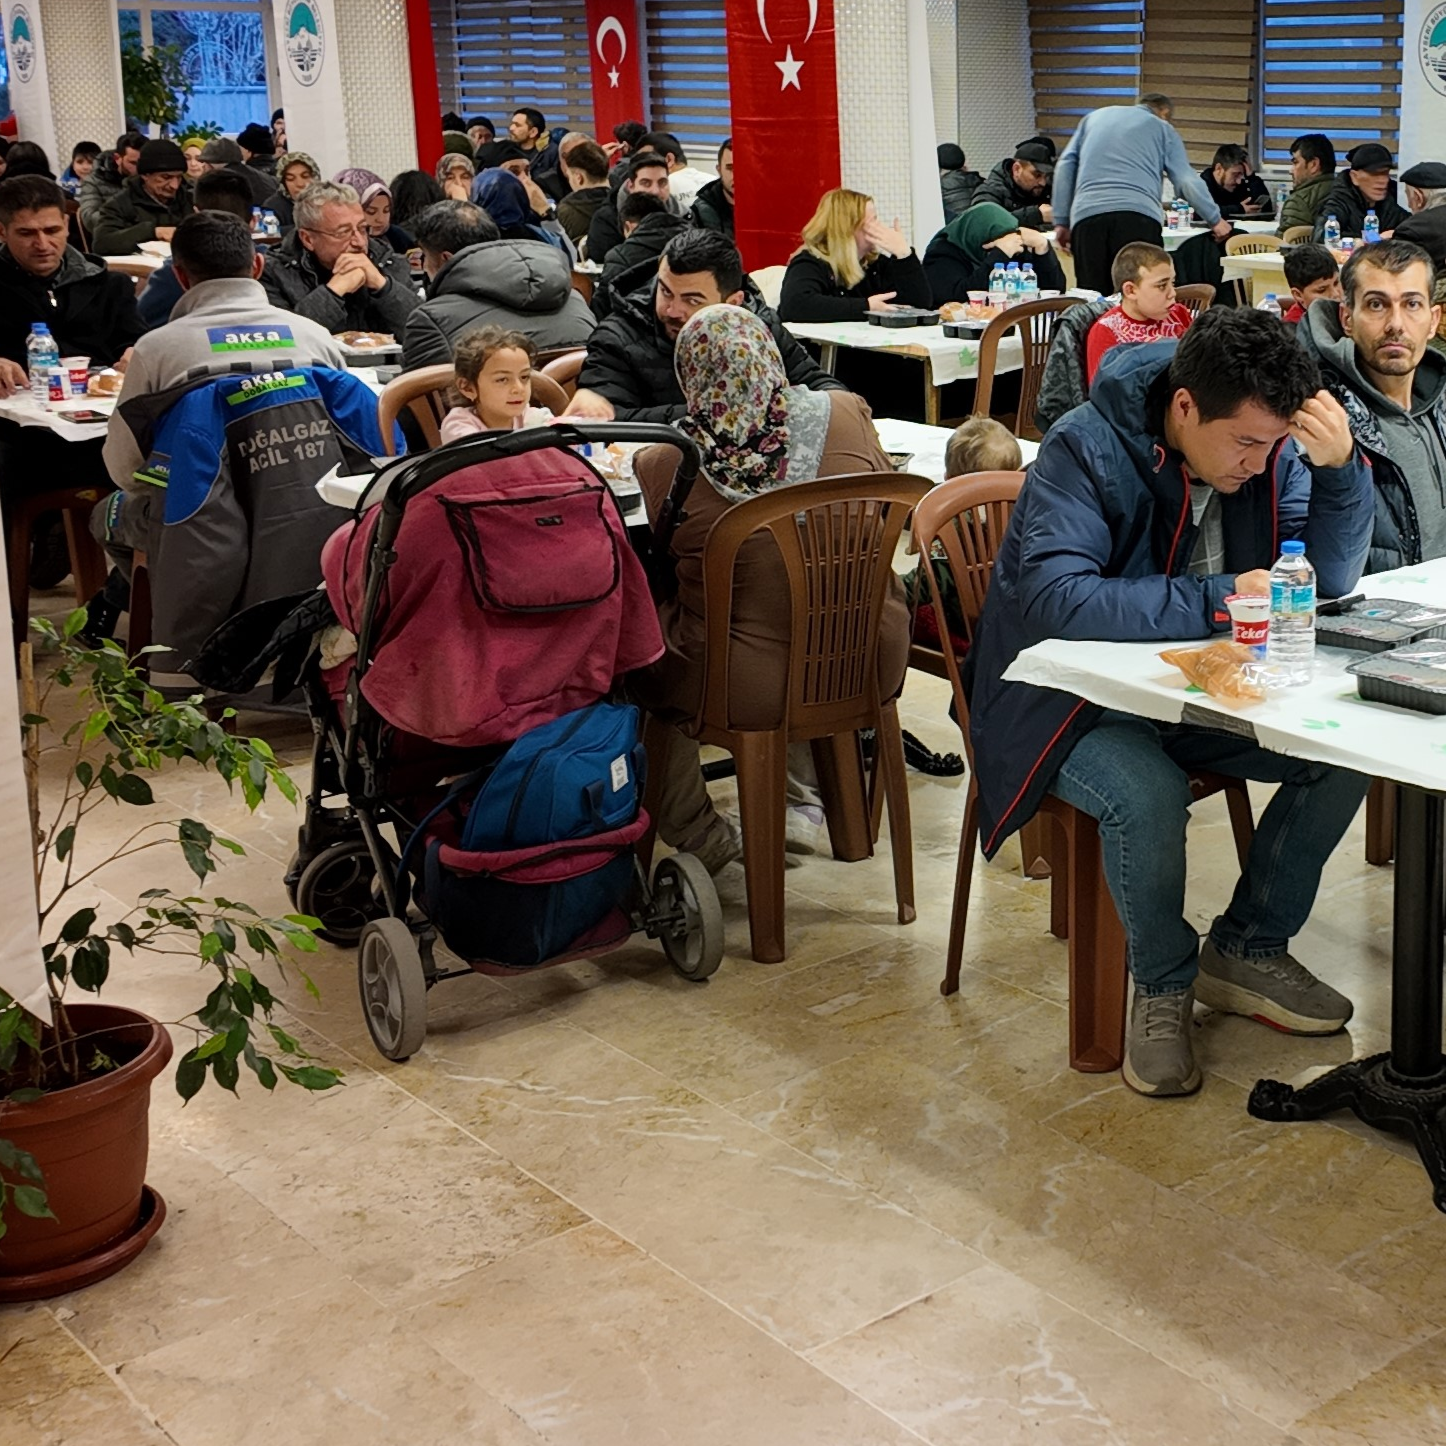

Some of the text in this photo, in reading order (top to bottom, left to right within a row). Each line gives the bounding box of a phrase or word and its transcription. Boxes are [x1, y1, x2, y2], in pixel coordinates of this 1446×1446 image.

[225, 331, 280, 344] aksa
[240, 371, 285, 391] aksa
[249, 440, 325, 474] ACİL 187
